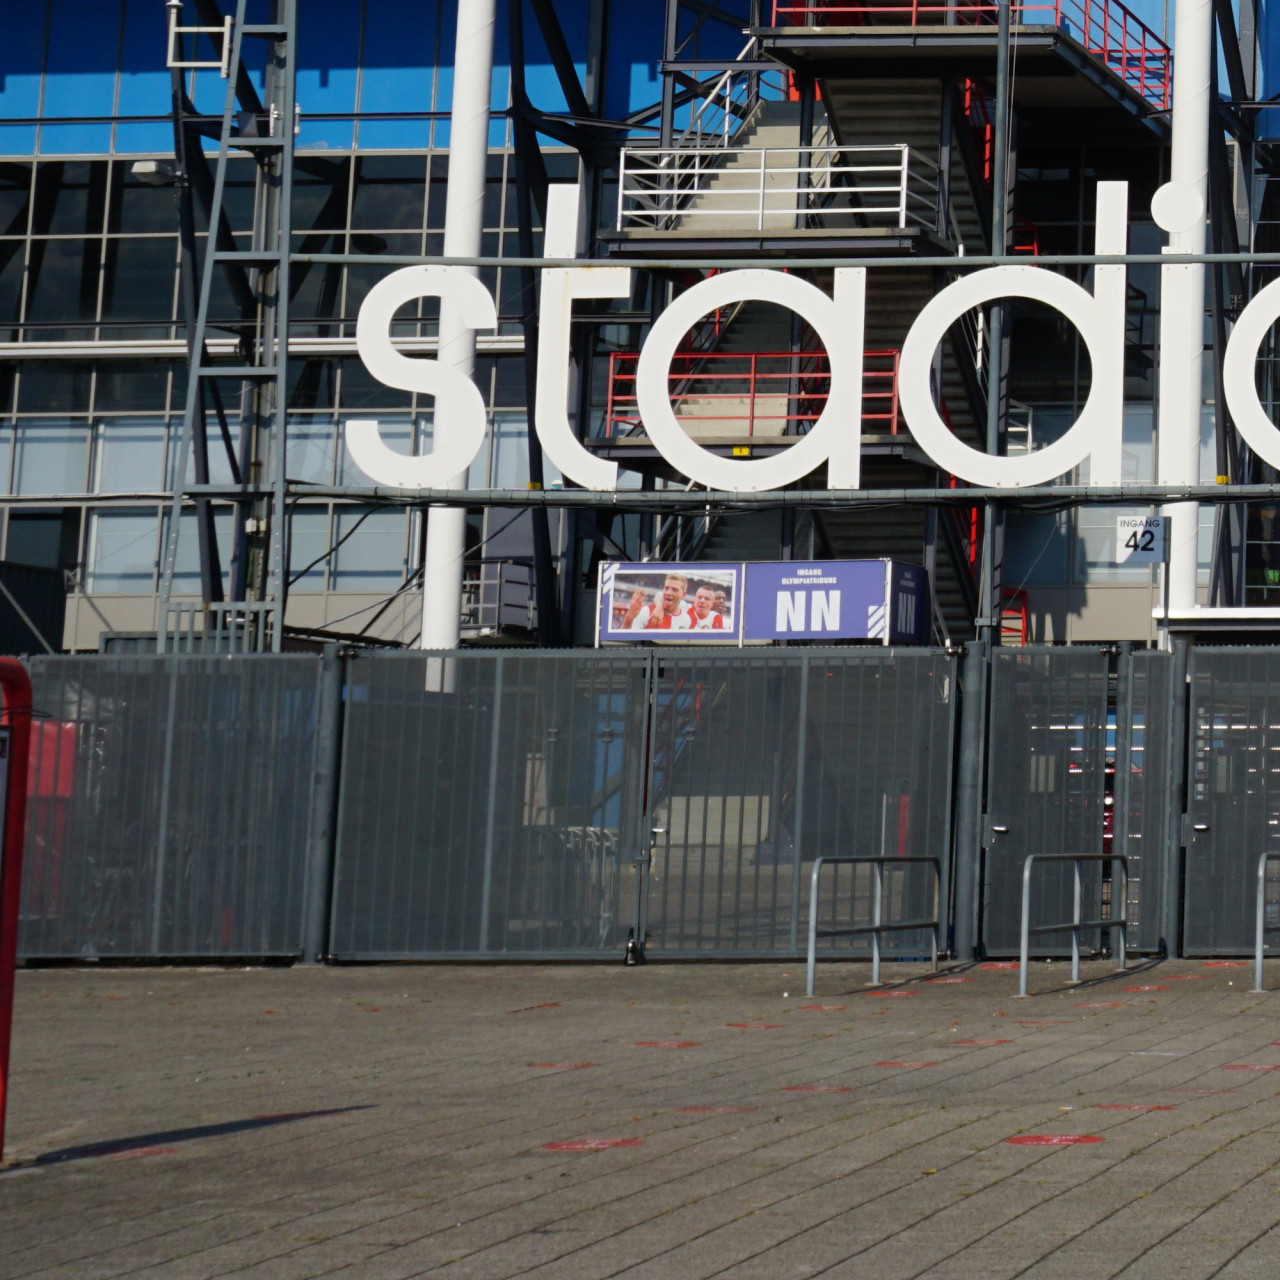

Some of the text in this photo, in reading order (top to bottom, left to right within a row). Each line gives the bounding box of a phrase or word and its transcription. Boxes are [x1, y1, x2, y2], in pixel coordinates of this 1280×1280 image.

[1120, 519, 1160, 528] INGANG
[1125, 530, 1155, 552] 42
[797, 568, 822, 576] INGANG
[775, 589, 841, 632] NN
